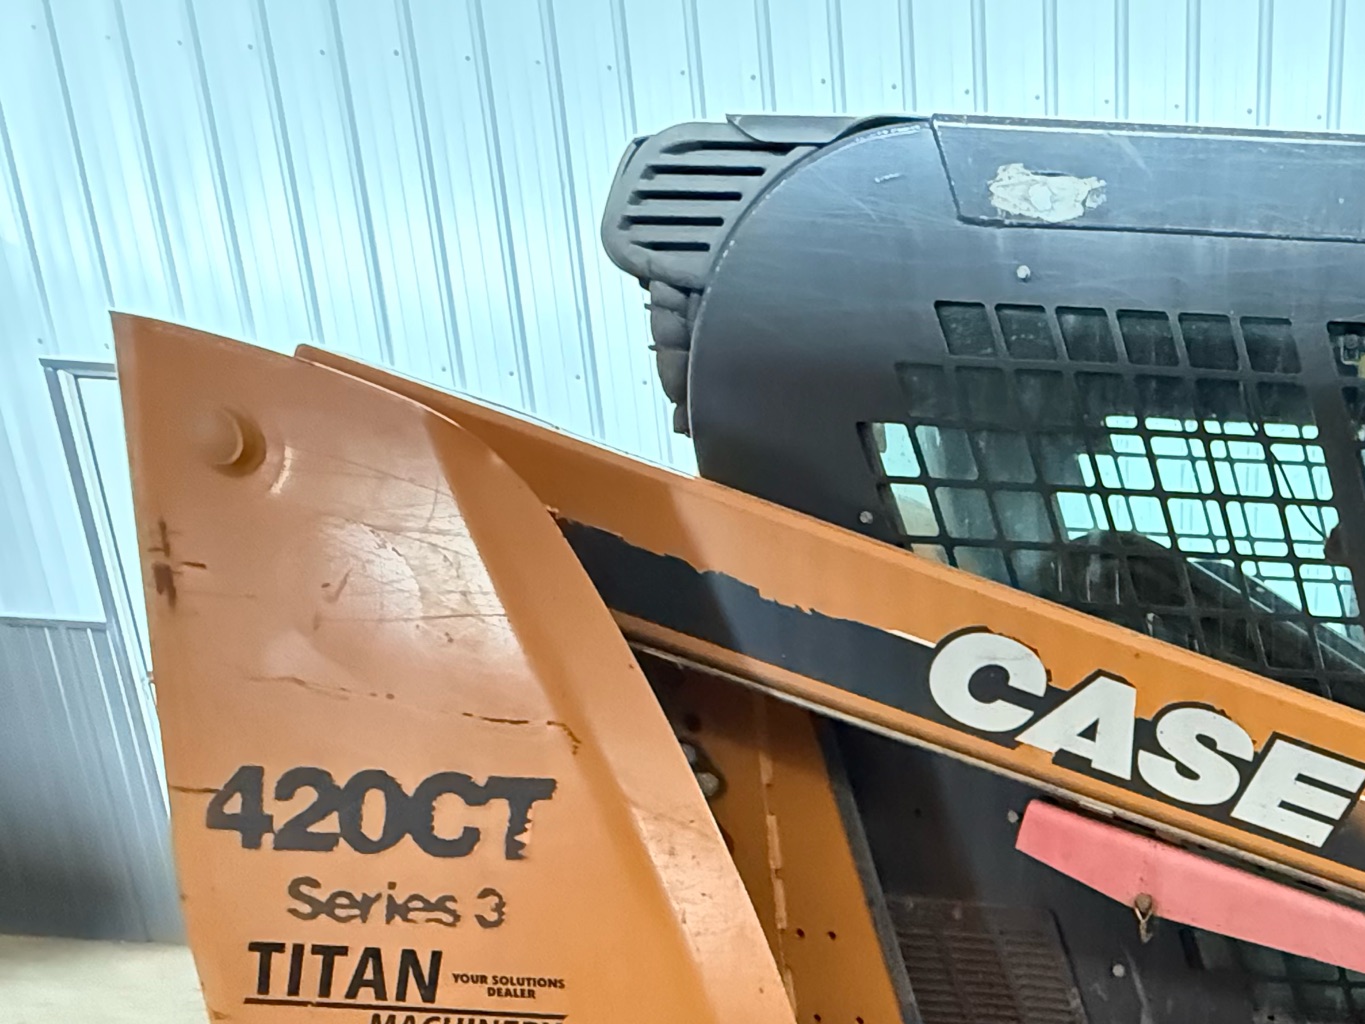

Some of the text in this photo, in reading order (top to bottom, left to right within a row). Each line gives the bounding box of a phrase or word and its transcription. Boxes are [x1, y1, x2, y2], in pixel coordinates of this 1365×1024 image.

[206, 765, 557, 860] 420CT
[287, 876, 506, 928] Series 3
[248, 941, 443, 1004] TITAN
[452, 973, 566, 989] YOUR SOLUTIONS
[487, 987, 536, 999] DEALER
